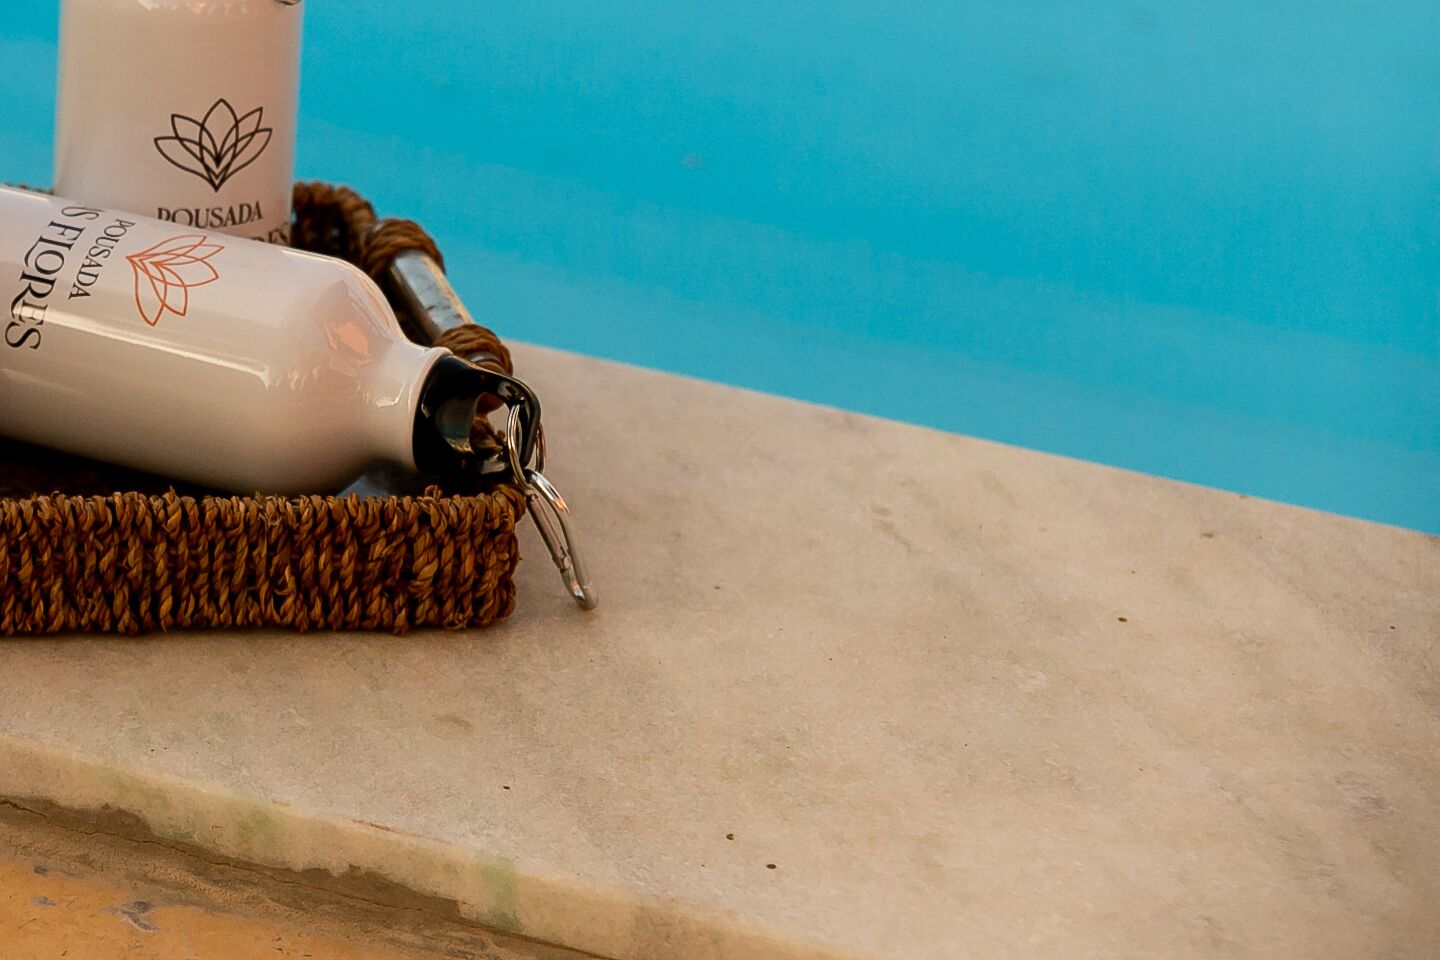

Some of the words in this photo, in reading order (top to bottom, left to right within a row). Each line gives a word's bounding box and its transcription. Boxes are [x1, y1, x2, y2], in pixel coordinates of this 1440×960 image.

[157, 200, 263, 229] POUSADA
[4, 220, 86, 350] FLORES
[68, 218, 136, 300] POUSADA
